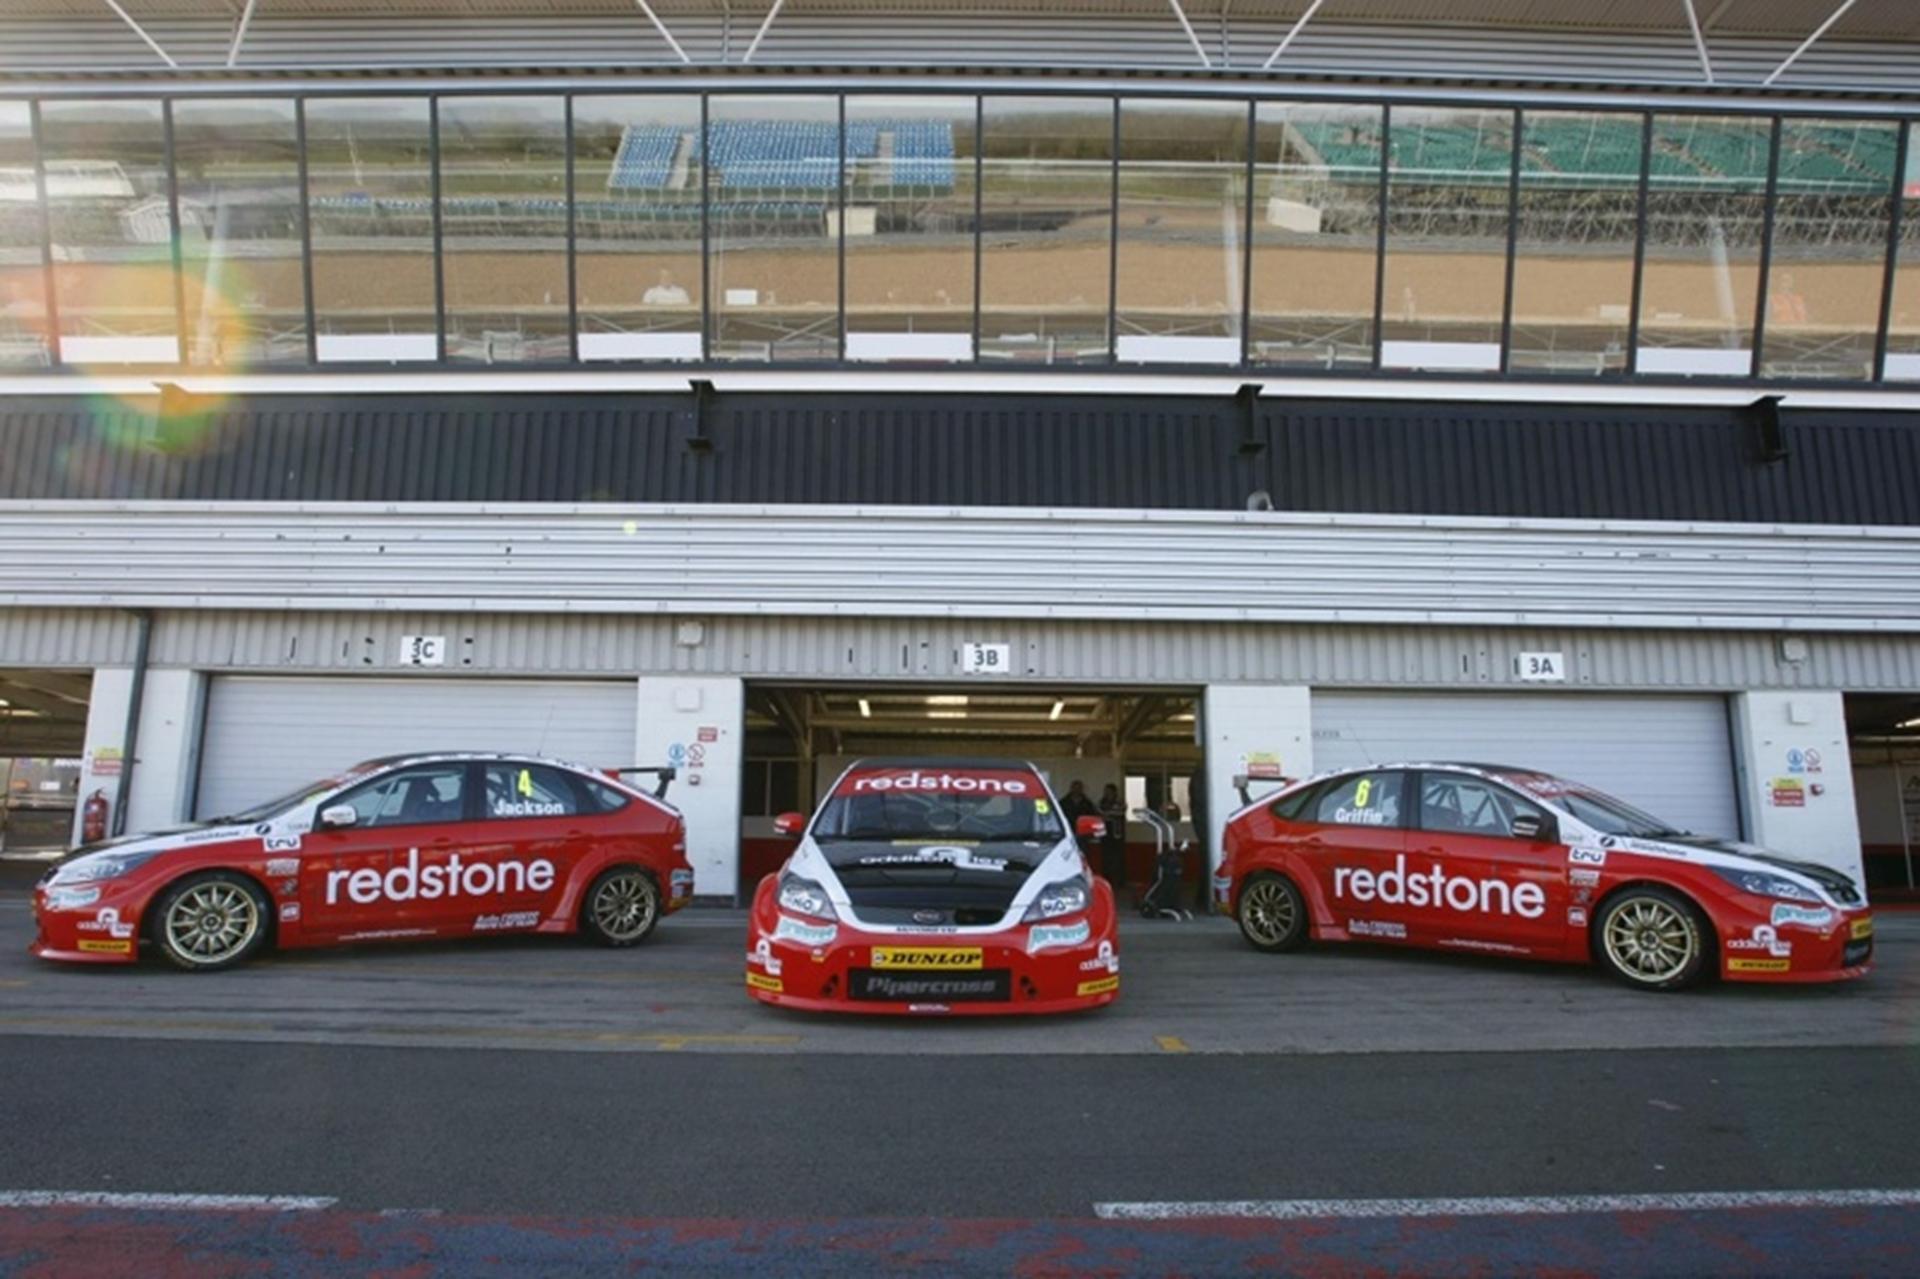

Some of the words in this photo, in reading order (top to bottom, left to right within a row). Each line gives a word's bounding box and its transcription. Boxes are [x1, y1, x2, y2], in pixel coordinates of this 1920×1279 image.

[411, 641, 435, 659] 3C
[974, 649, 999, 666] 3B
[1530, 657, 1555, 674] 3A
[517, 769, 534, 798] 4
[854, 772, 1027, 793] redstone
[1354, 779, 1371, 808] 6
[494, 800, 565, 816] Jackson
[1034, 799, 1049, 814] 5
[1335, 807, 1383, 824] Griffin
[1571, 848, 1602, 862] tru
[326, 848, 555, 904] redstone
[1334, 854, 1546, 919] redstone
[890, 952, 982, 966] DUNLOP
[866, 976, 997, 996] Pipercross
